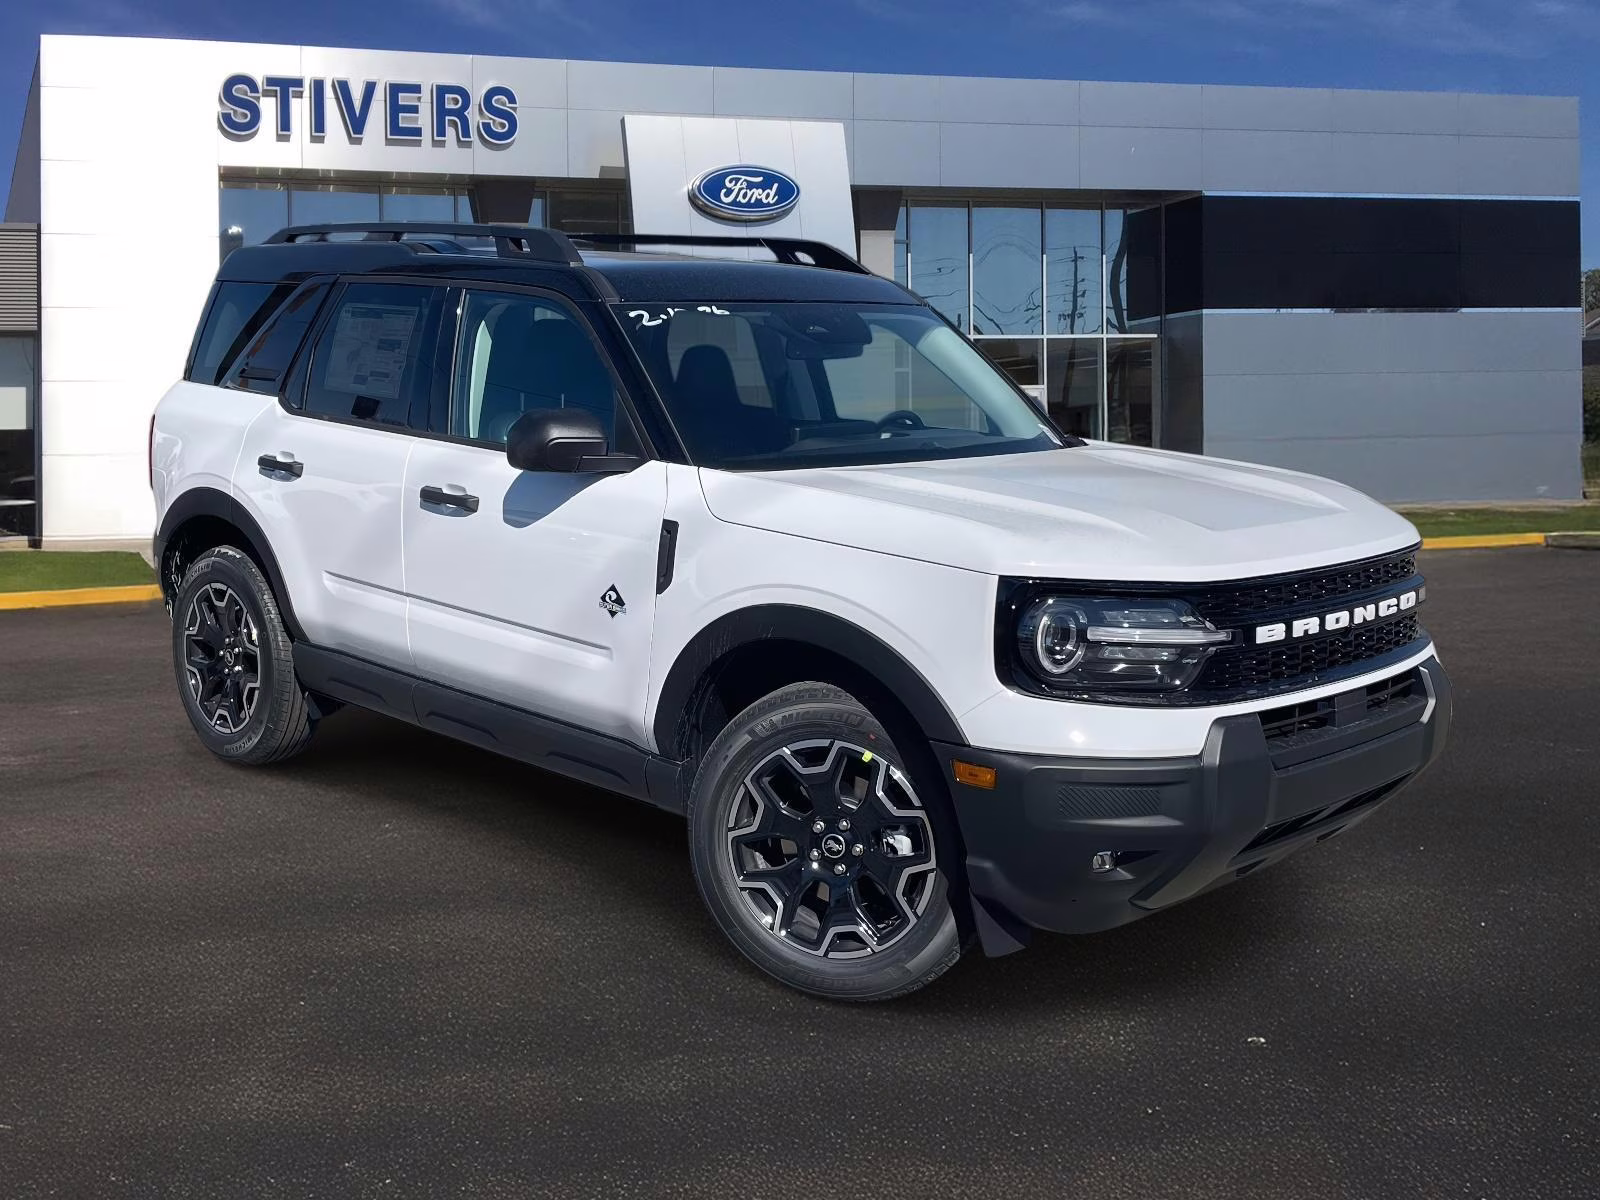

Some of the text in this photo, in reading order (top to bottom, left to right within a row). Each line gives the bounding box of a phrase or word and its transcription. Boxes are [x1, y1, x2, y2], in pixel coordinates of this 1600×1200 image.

[217, 72, 519, 145] STIVERS
[720, 174, 778, 204] Ford
[1255, 591, 1417, 644] BRONCO
[780, 709, 864, 727] MICHELIN
